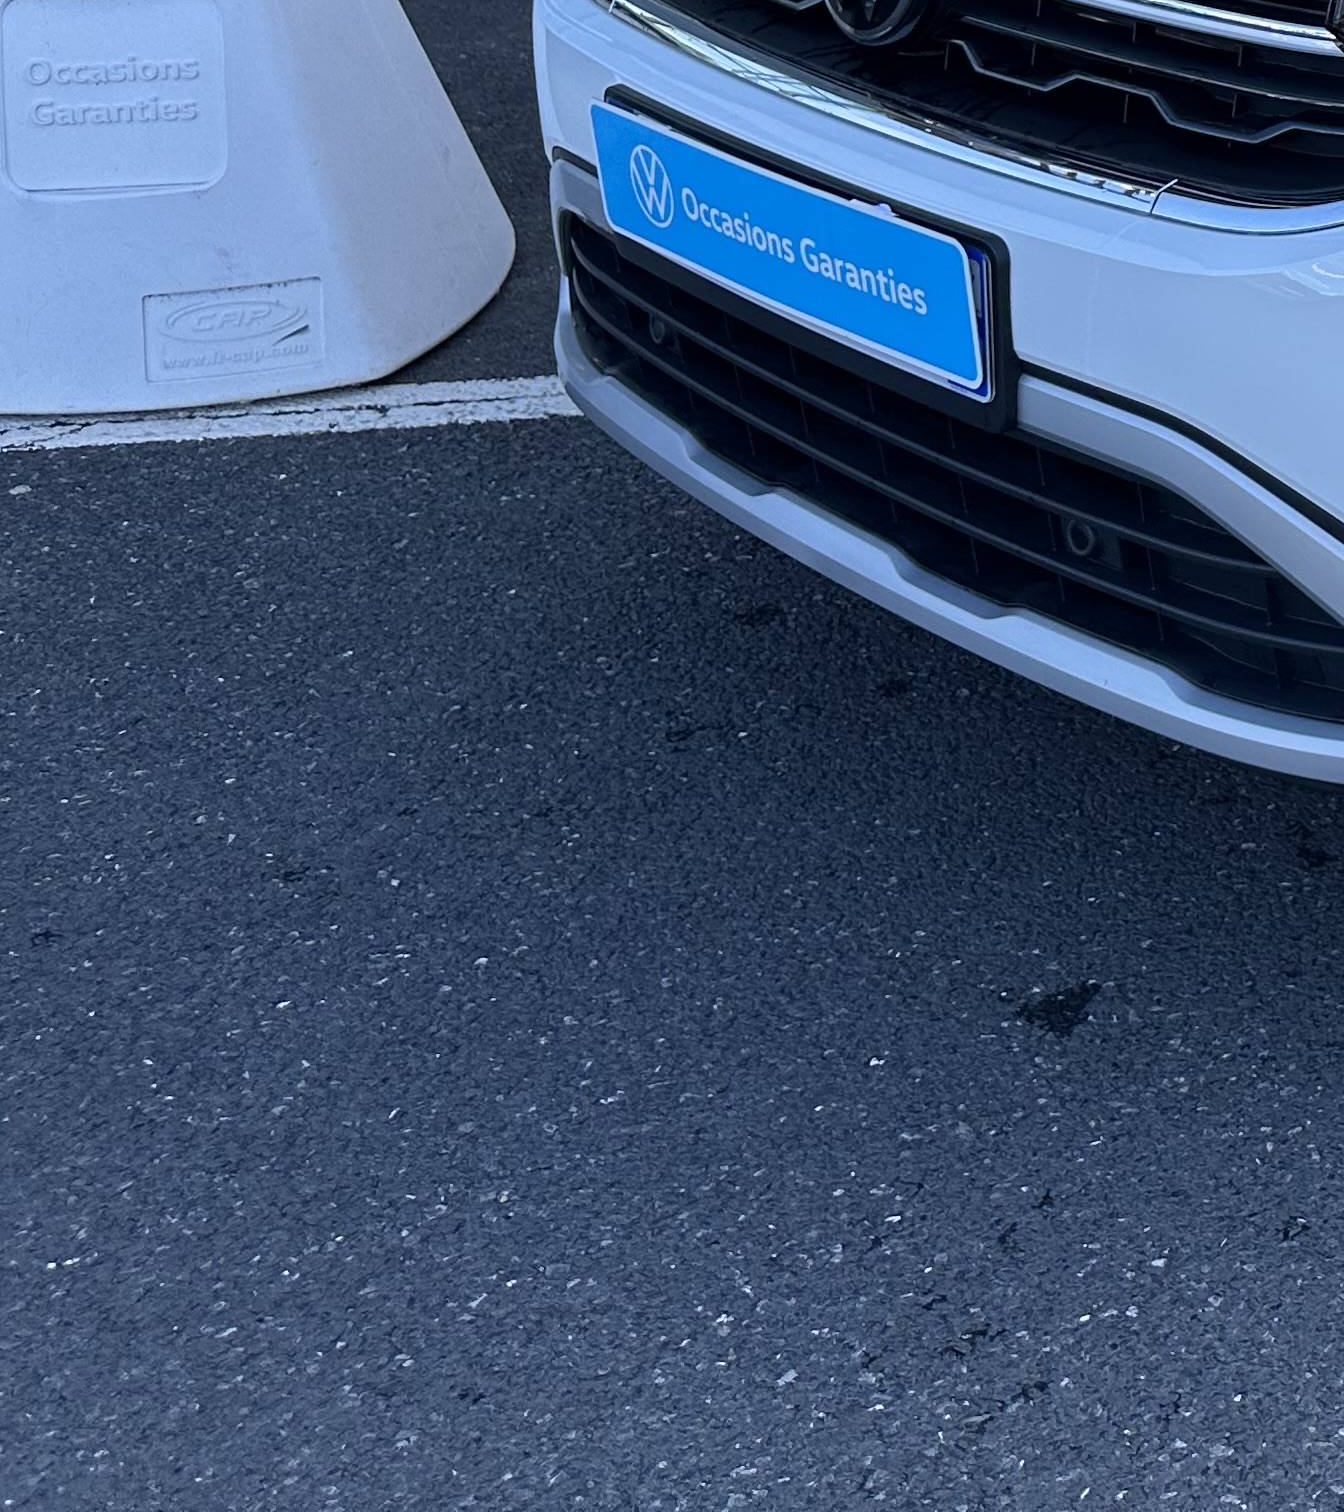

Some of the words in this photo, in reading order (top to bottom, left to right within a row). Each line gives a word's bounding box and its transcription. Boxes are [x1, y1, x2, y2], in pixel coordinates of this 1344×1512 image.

[25, 56, 200, 86] Occasions
[31, 97, 199, 126] Garanties
[680, 187, 796, 263] Occasions
[799, 237, 929, 316] Garanties
